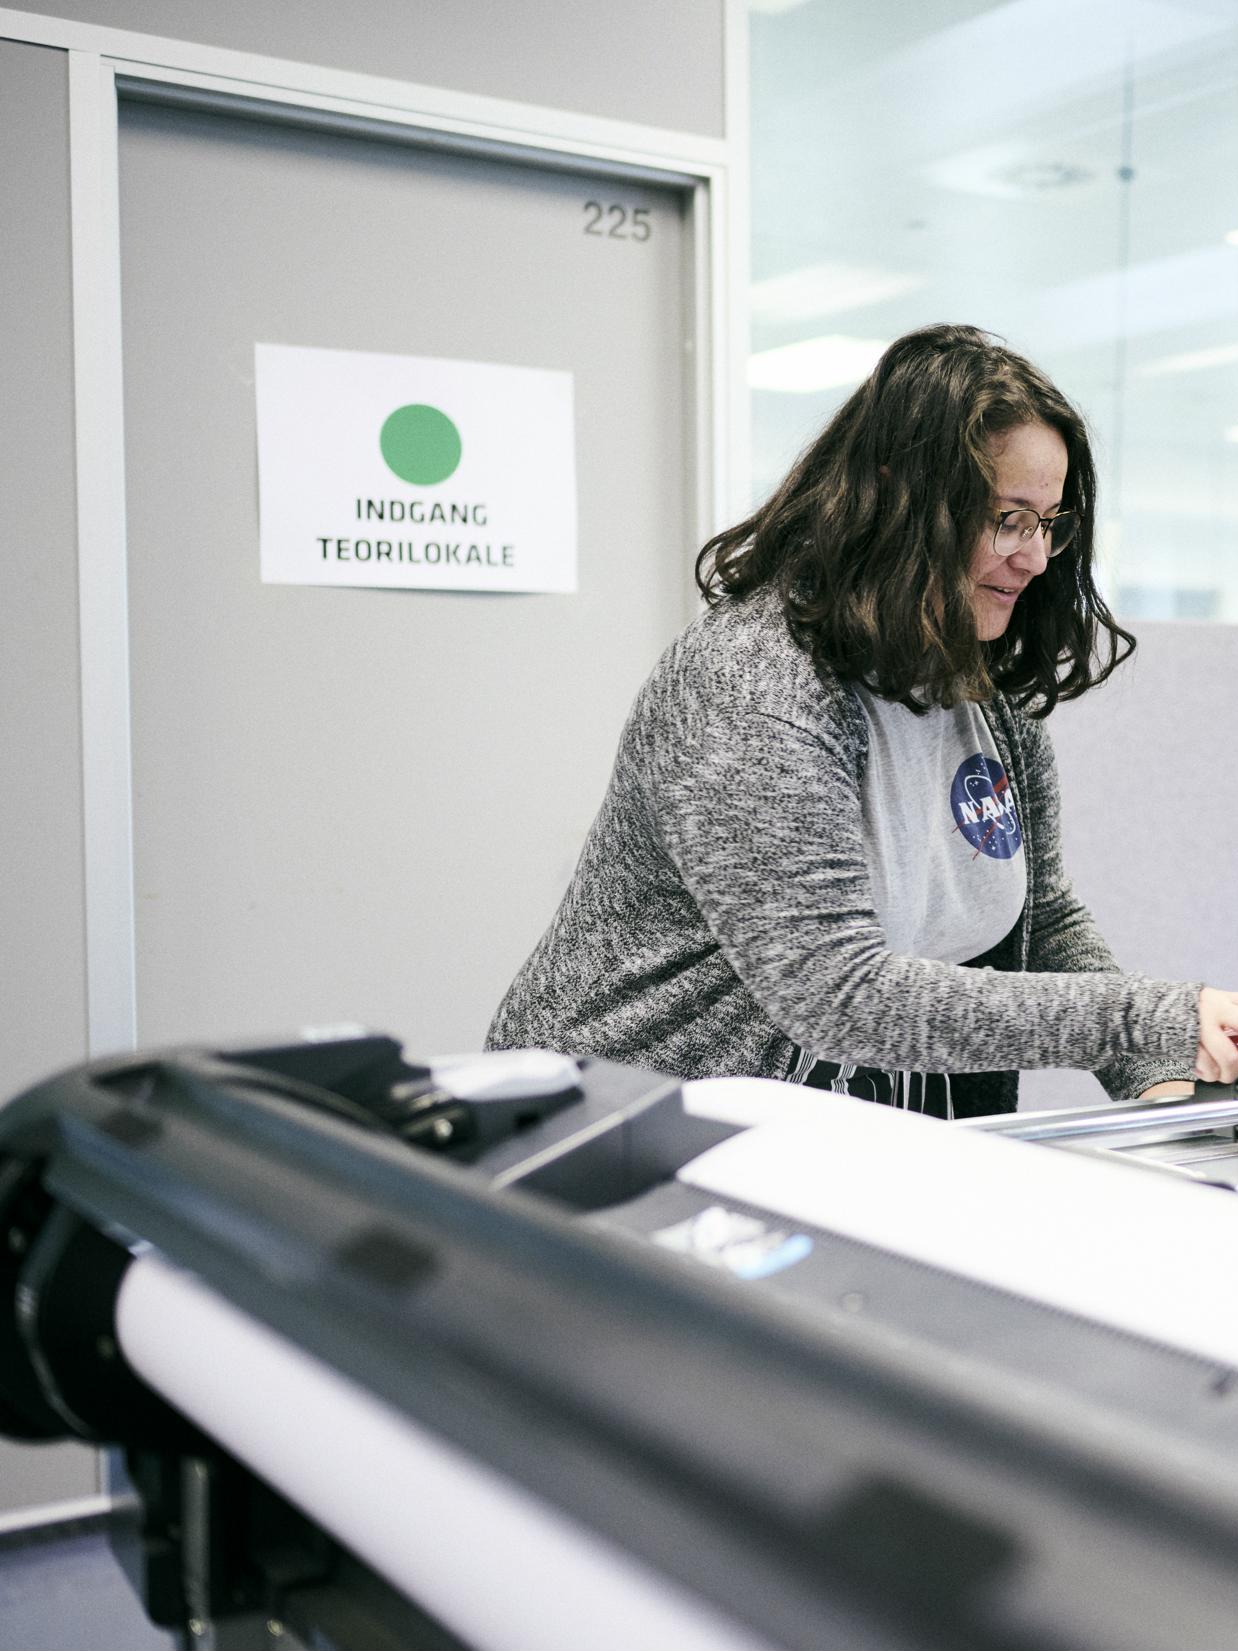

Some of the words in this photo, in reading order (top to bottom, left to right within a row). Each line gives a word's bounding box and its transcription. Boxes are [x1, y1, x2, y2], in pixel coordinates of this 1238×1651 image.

[583, 200, 651, 242] 225
[355, 498, 488, 526] INDGANG
[316, 538, 516, 567] TEORILOKALE
